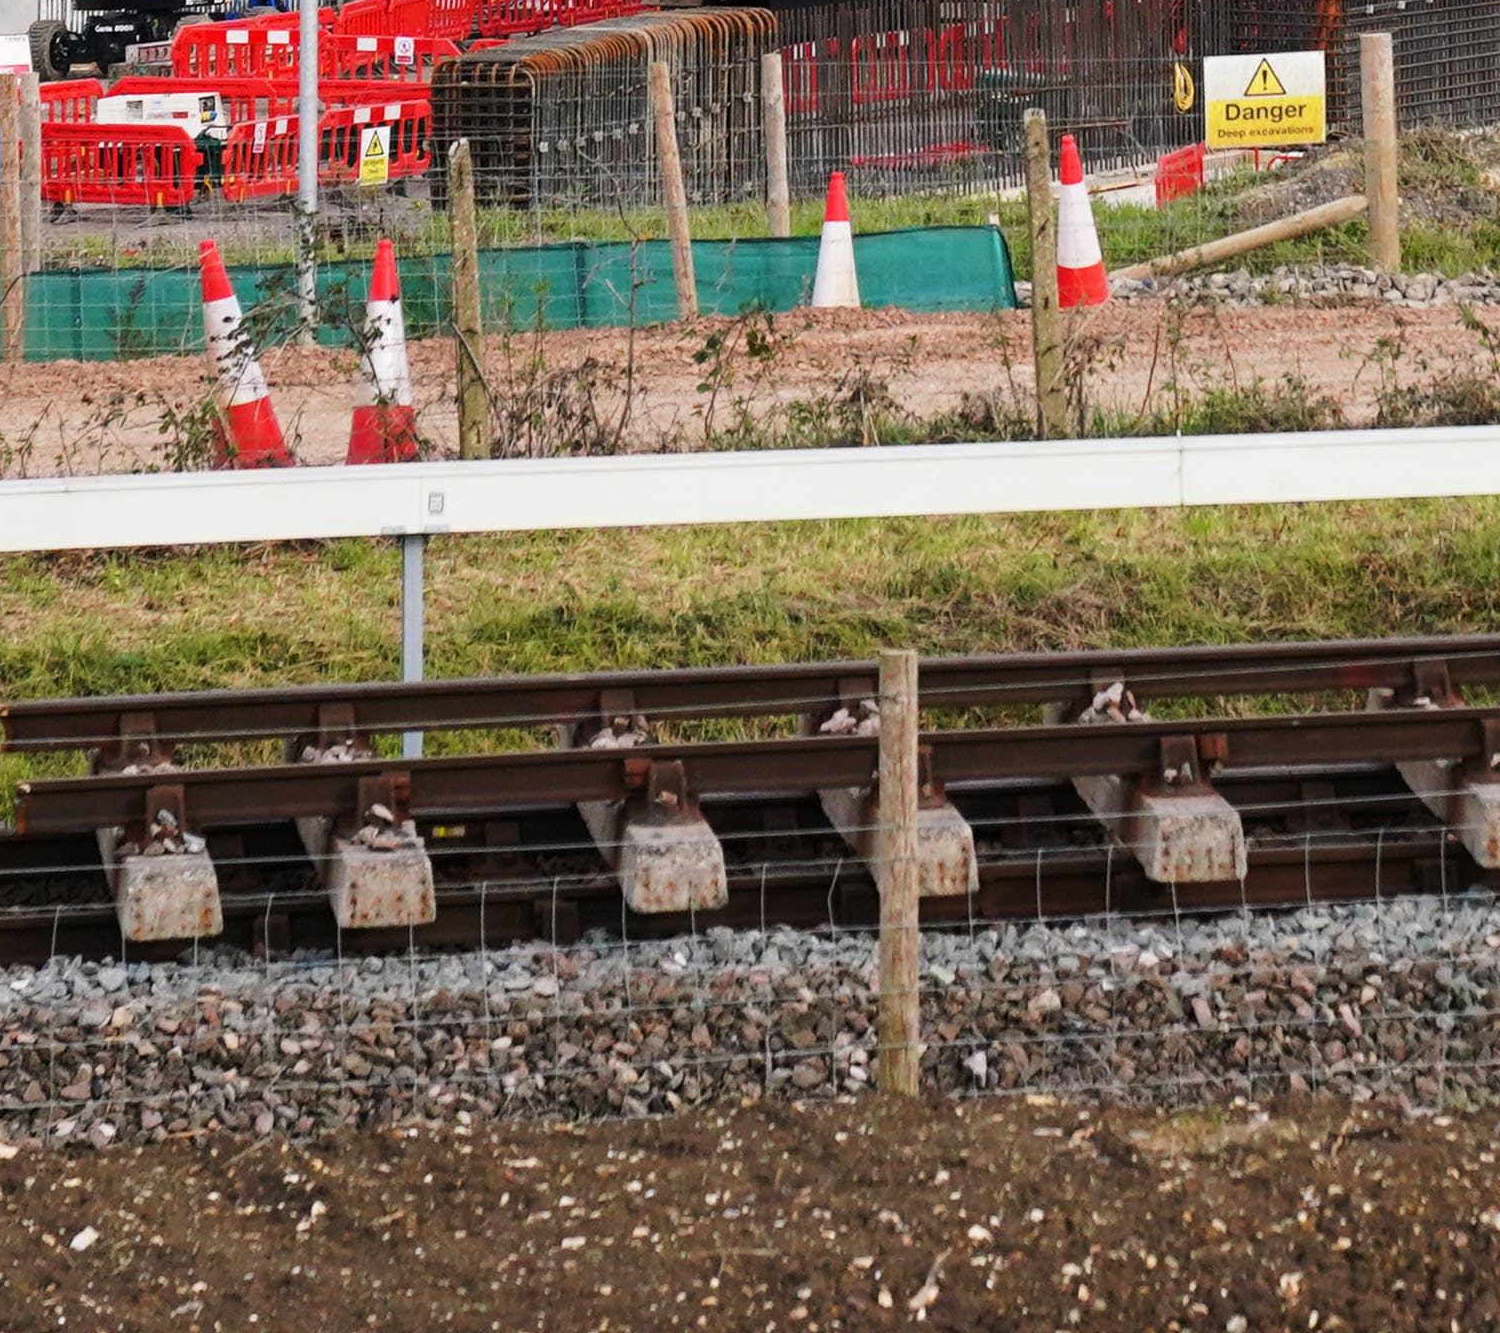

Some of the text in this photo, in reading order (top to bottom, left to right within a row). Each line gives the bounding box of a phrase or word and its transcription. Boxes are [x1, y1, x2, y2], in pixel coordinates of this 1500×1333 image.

[1225, 104, 1307, 123] Danger
[1217, 125, 1314, 139] Deep excavations
